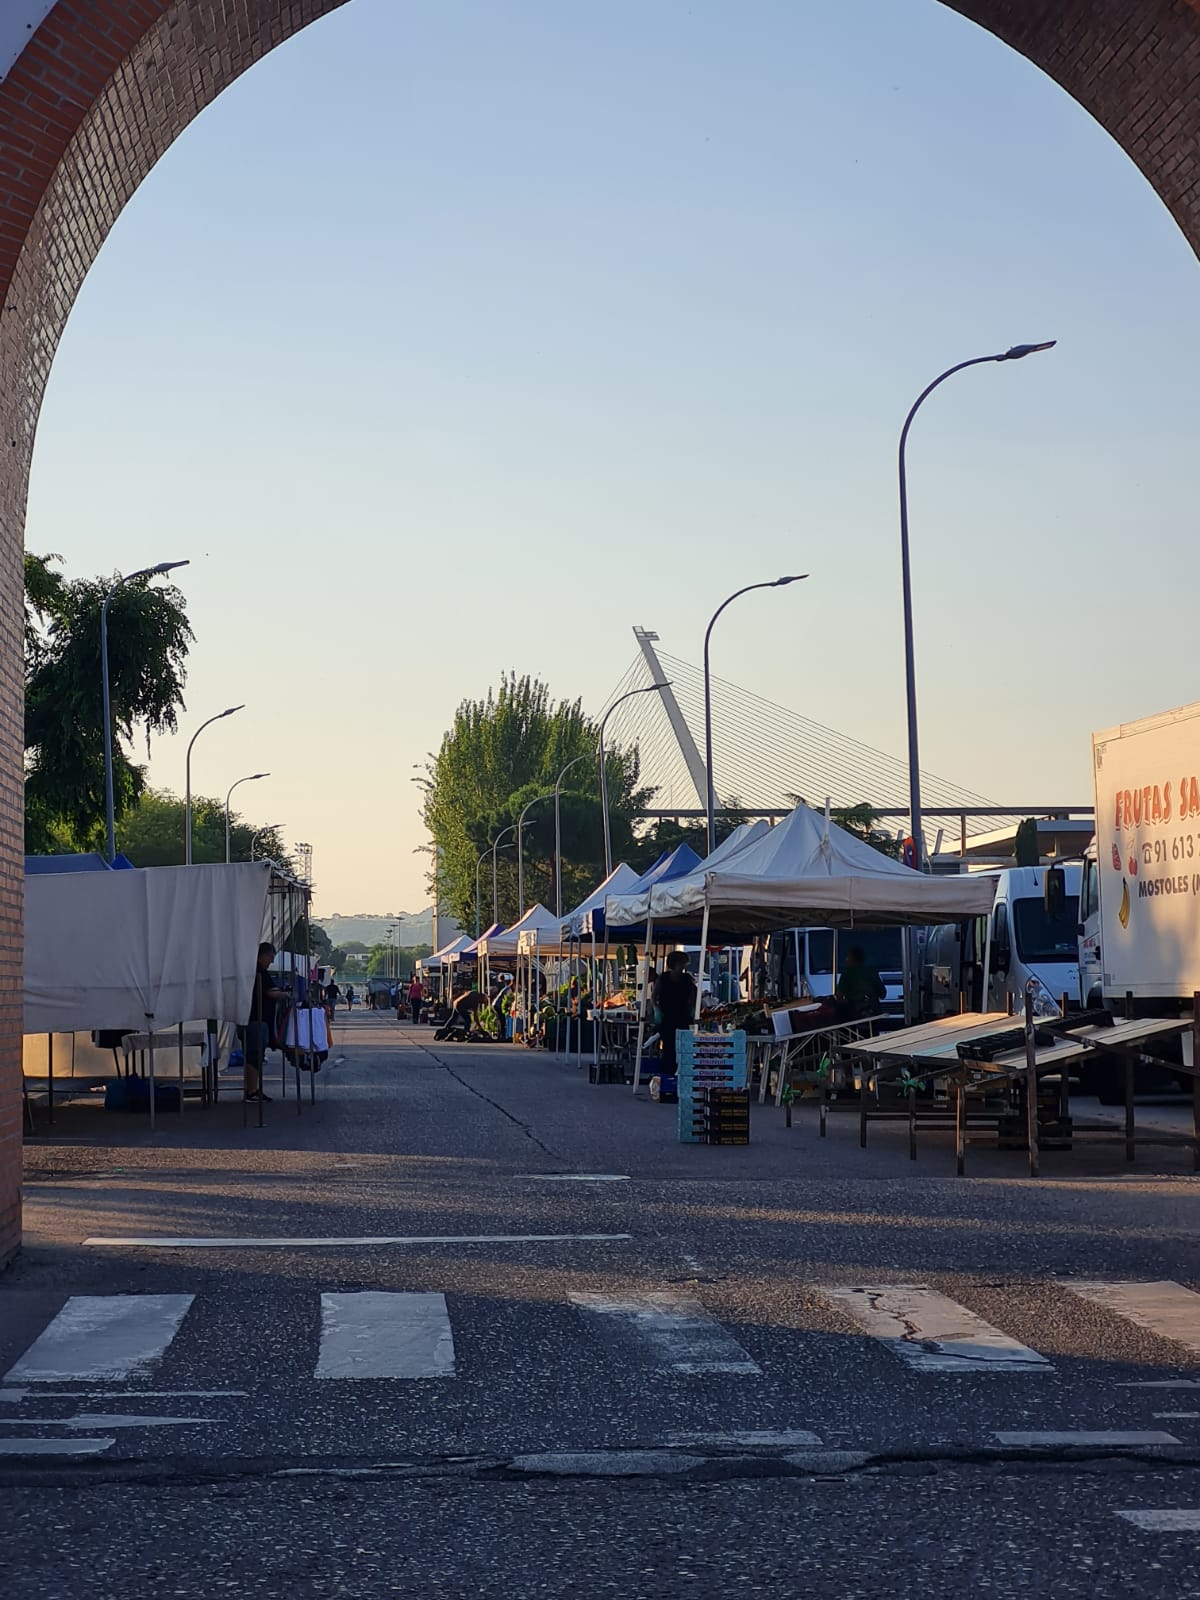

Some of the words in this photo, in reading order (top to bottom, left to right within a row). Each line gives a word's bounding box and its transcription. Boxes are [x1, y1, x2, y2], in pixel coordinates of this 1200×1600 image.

[1115, 781, 1171, 831] FRUTAS
[1154, 839, 1167, 863] 91
[1172, 834, 1194, 860] 613
[1138, 874, 1189, 898] MOSTOLES
